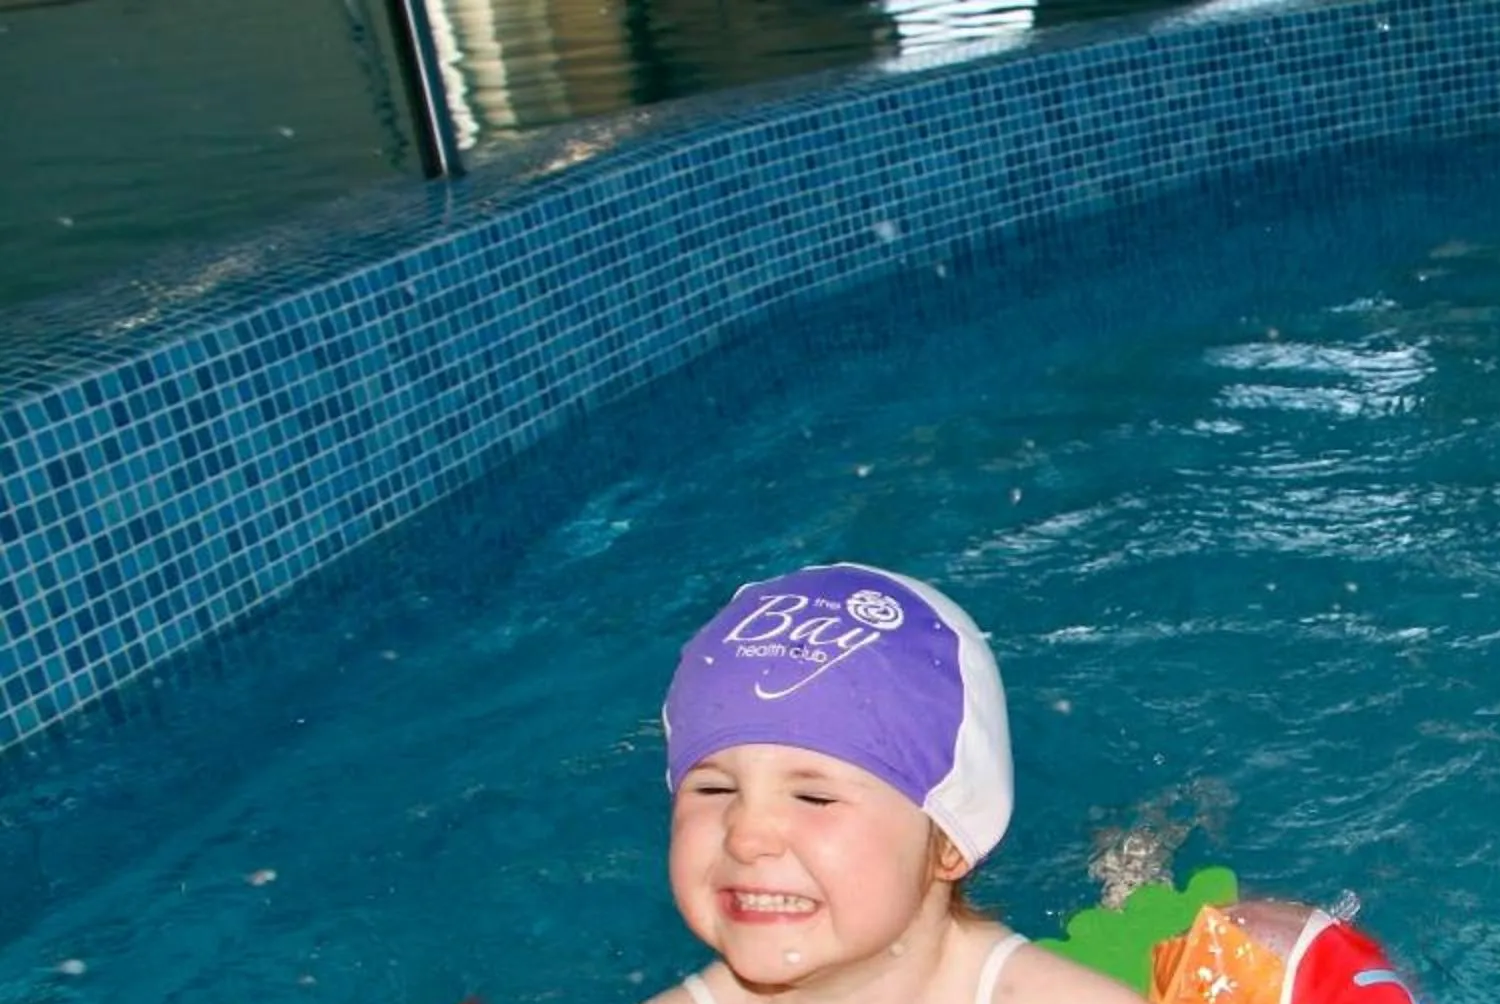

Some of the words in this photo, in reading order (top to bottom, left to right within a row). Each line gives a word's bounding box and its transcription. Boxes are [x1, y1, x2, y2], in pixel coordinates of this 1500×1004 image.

[812, 597, 842, 611] the
[722, 593, 881, 700] Bay
[736, 643, 787, 659] health
[789, 646, 829, 664] club
